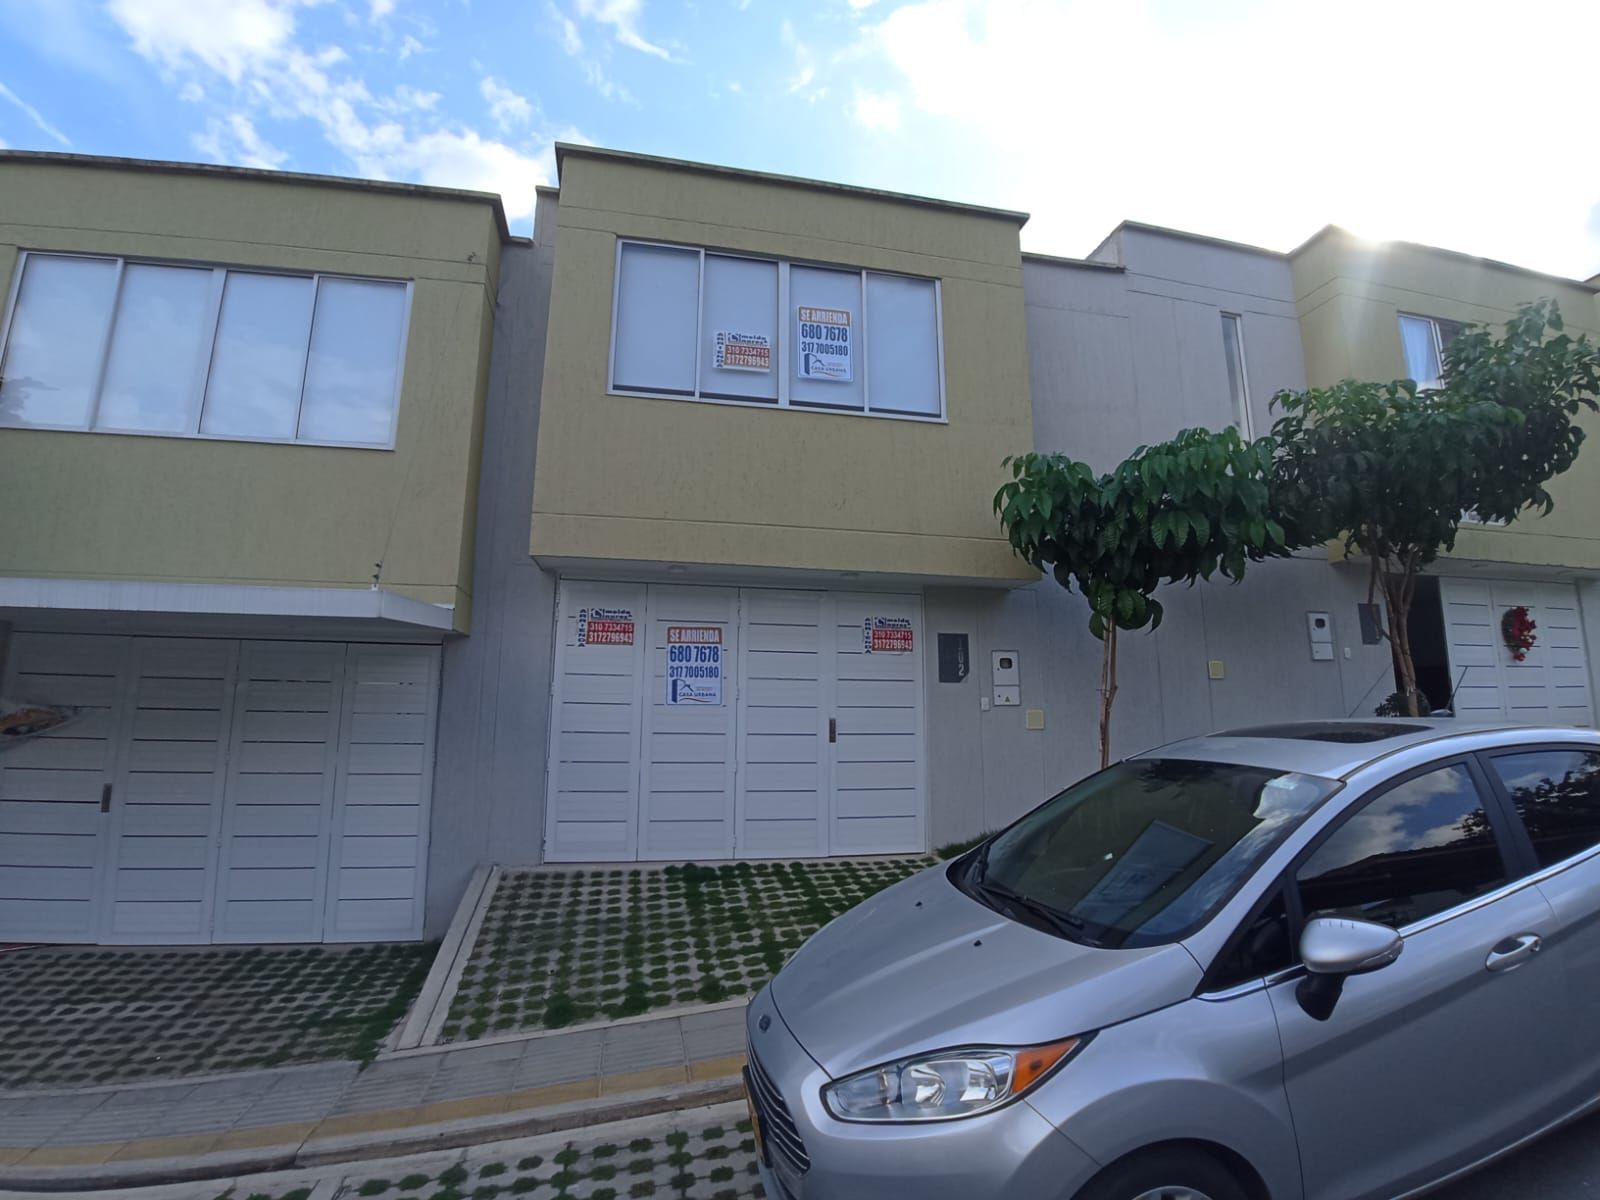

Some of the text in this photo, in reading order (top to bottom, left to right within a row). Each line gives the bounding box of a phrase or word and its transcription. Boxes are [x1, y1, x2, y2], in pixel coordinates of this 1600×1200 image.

[801, 309, 848, 325] SE ARRIENDA
[801, 323, 848, 342] 680 7678
[801, 341, 848, 356] 317 7005180
[670, 629, 720, 643] SE ARRIENDA
[669, 645, 720, 663] 680 7678
[669, 666, 720, 679] 317 7005180
